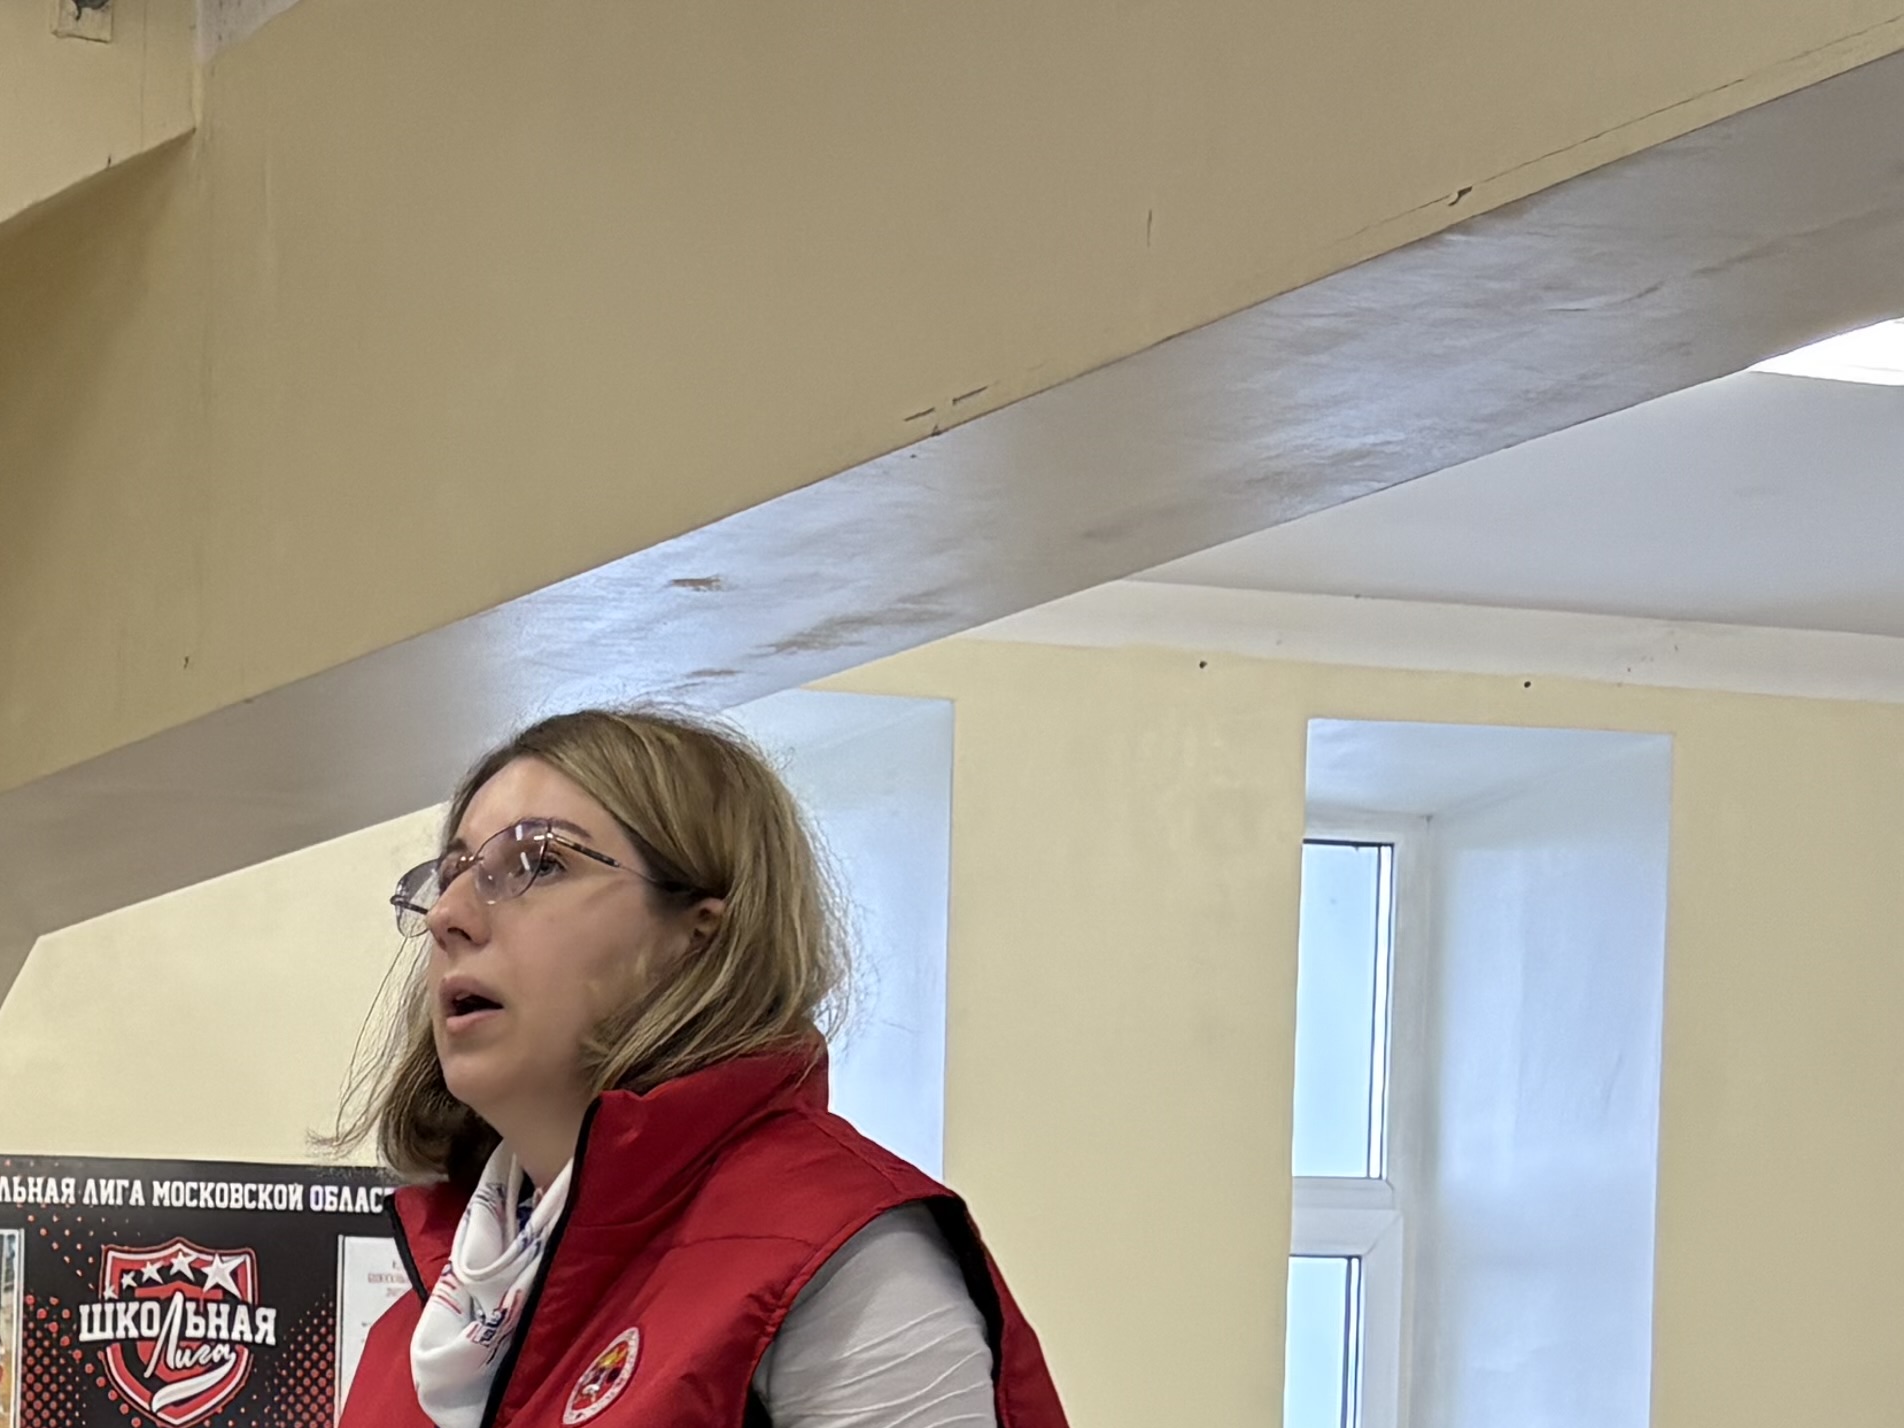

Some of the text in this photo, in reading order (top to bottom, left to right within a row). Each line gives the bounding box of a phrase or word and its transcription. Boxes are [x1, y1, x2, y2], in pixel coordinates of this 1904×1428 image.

[82, 1177, 145, 1206] ЛИГА
[152, 1179, 304, 1212] МОСКОВСКОЙ
[78, 1289, 277, 1346] ШКОЛЬНАЯ
